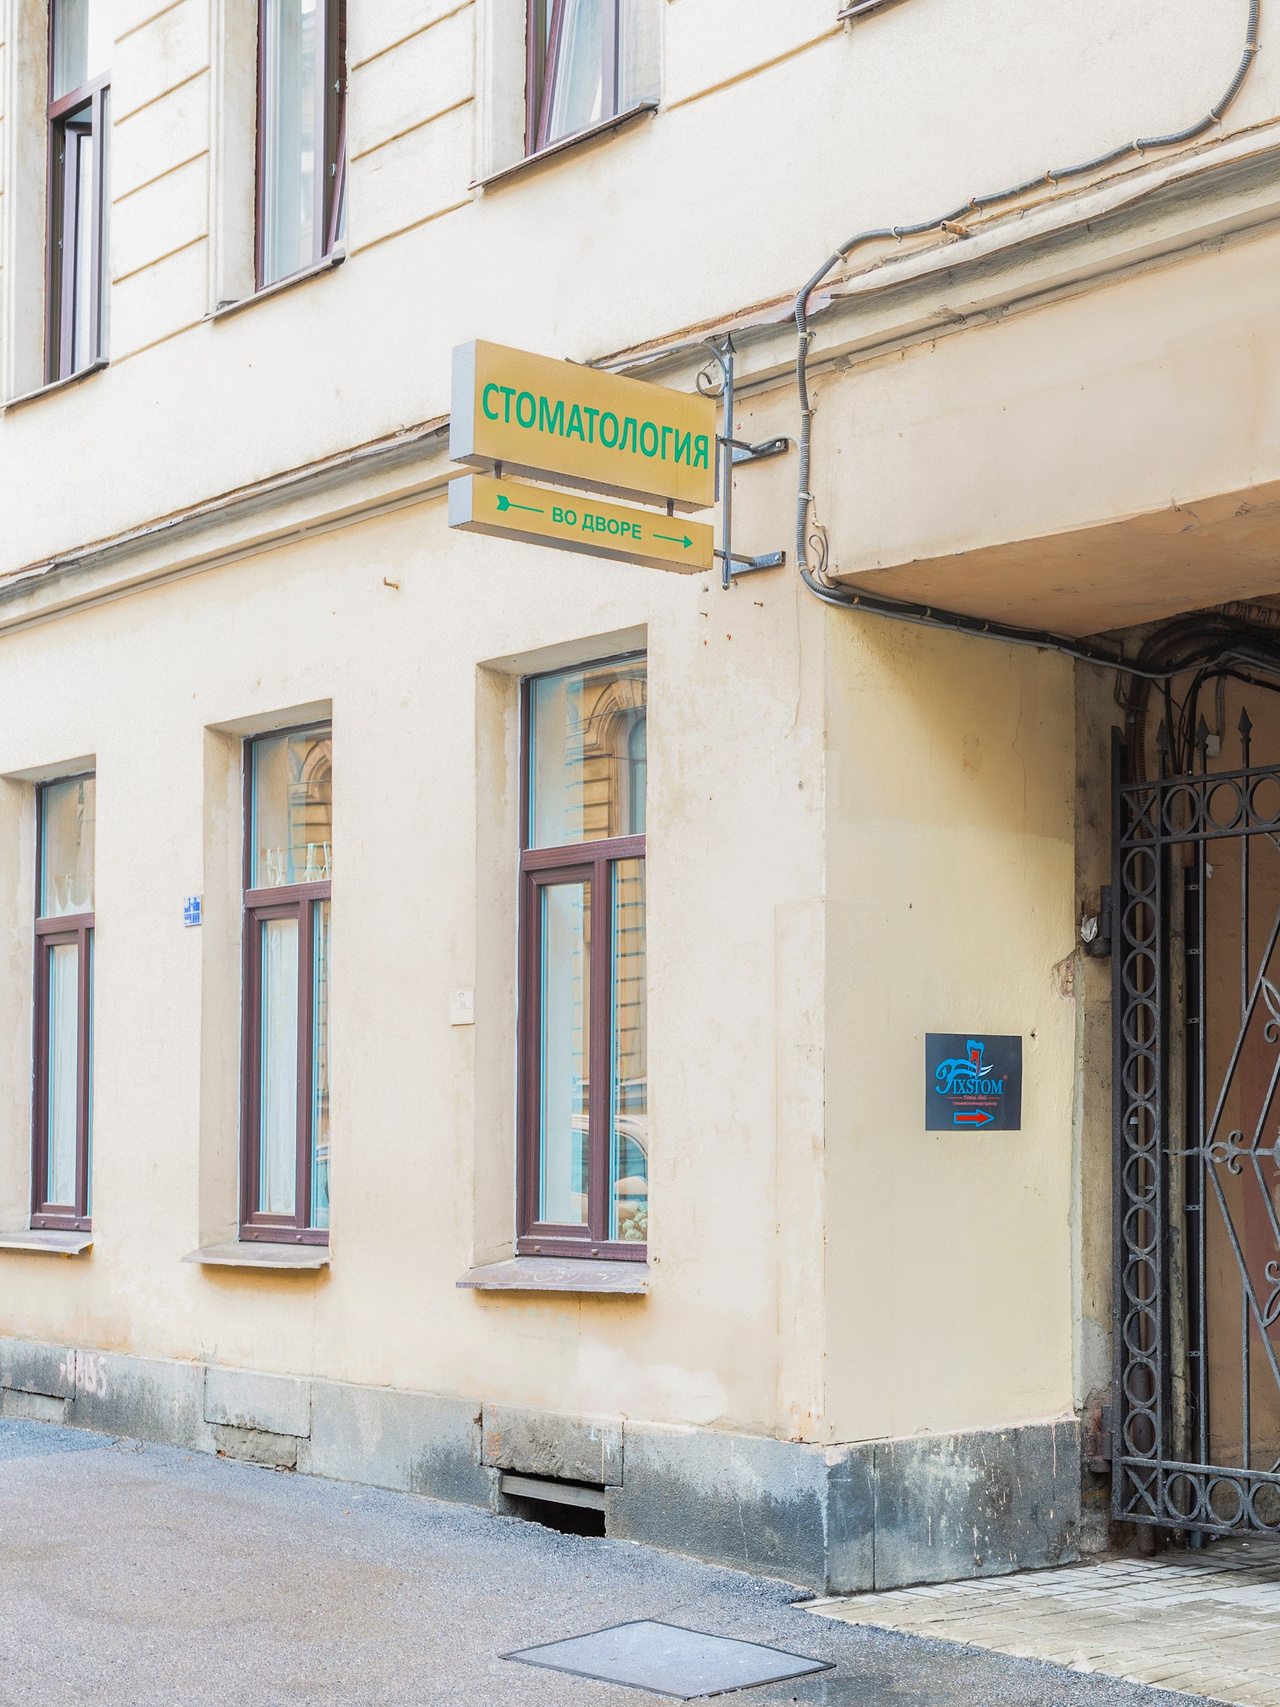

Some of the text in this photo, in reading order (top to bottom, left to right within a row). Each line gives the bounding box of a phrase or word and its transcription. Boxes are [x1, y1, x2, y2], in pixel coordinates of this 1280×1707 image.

[482, 382, 709, 470] СТОМАТОЛОГИЯ
[552, 506, 642, 541] ВО ДВОРЕ
